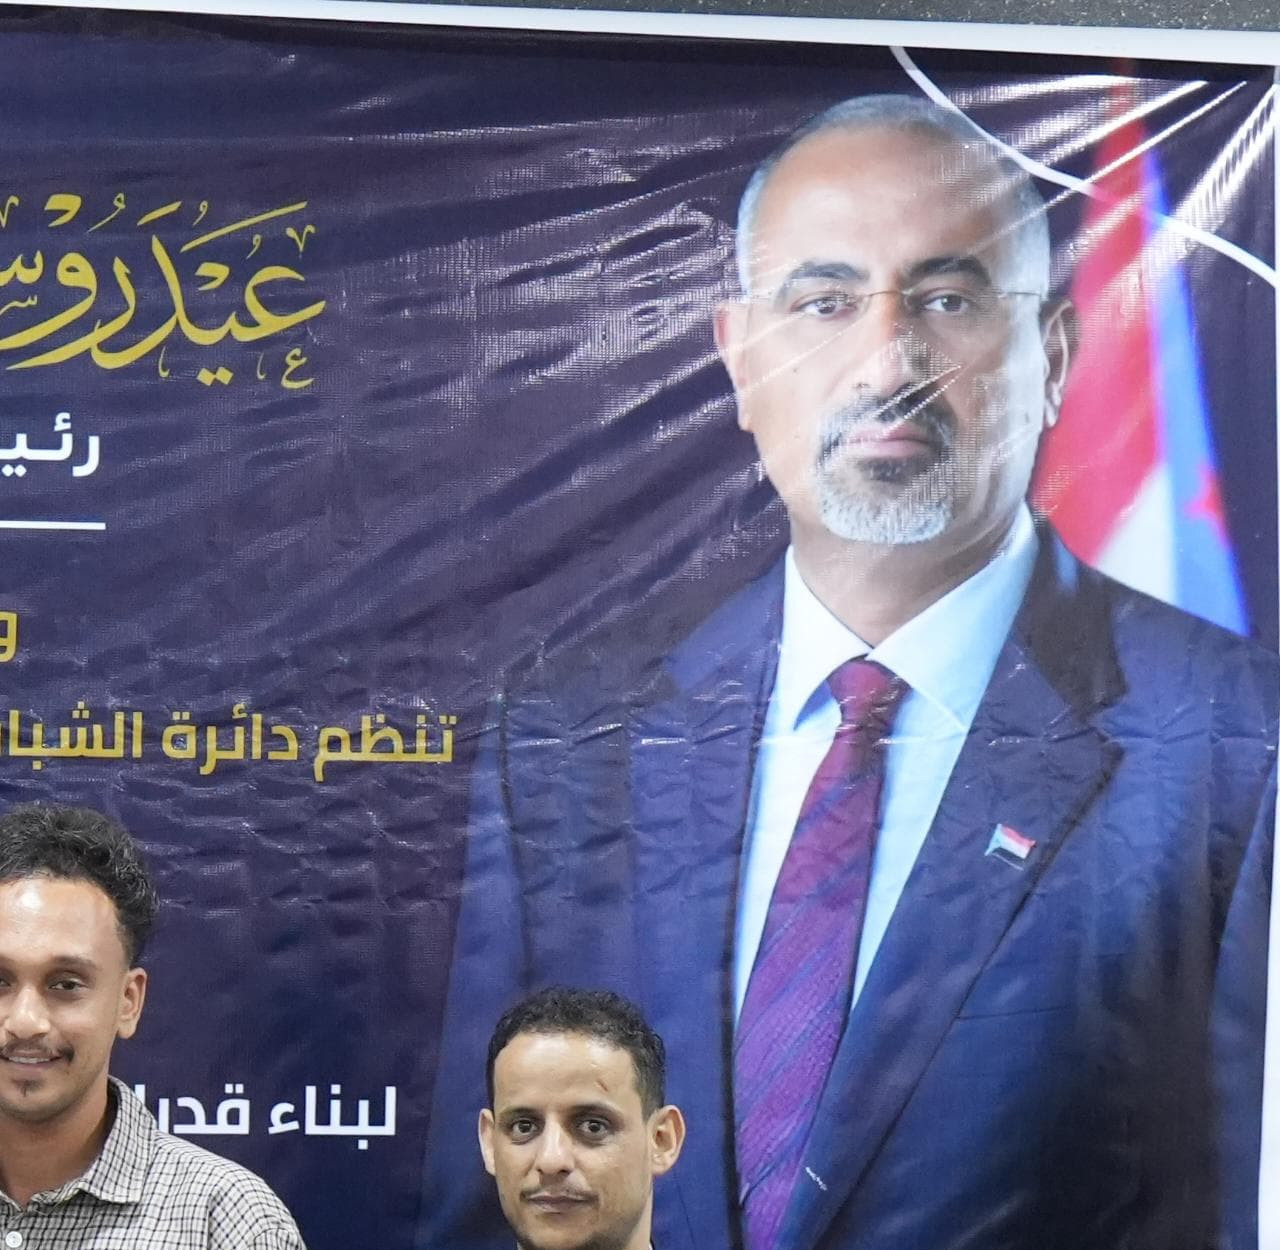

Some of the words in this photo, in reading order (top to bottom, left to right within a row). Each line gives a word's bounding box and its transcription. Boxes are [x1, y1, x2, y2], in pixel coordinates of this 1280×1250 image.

[162, 702, 298, 775] دائرة
[313, 711, 454, 782] تنظم
[268, 1083, 397, 1150] لبناء
